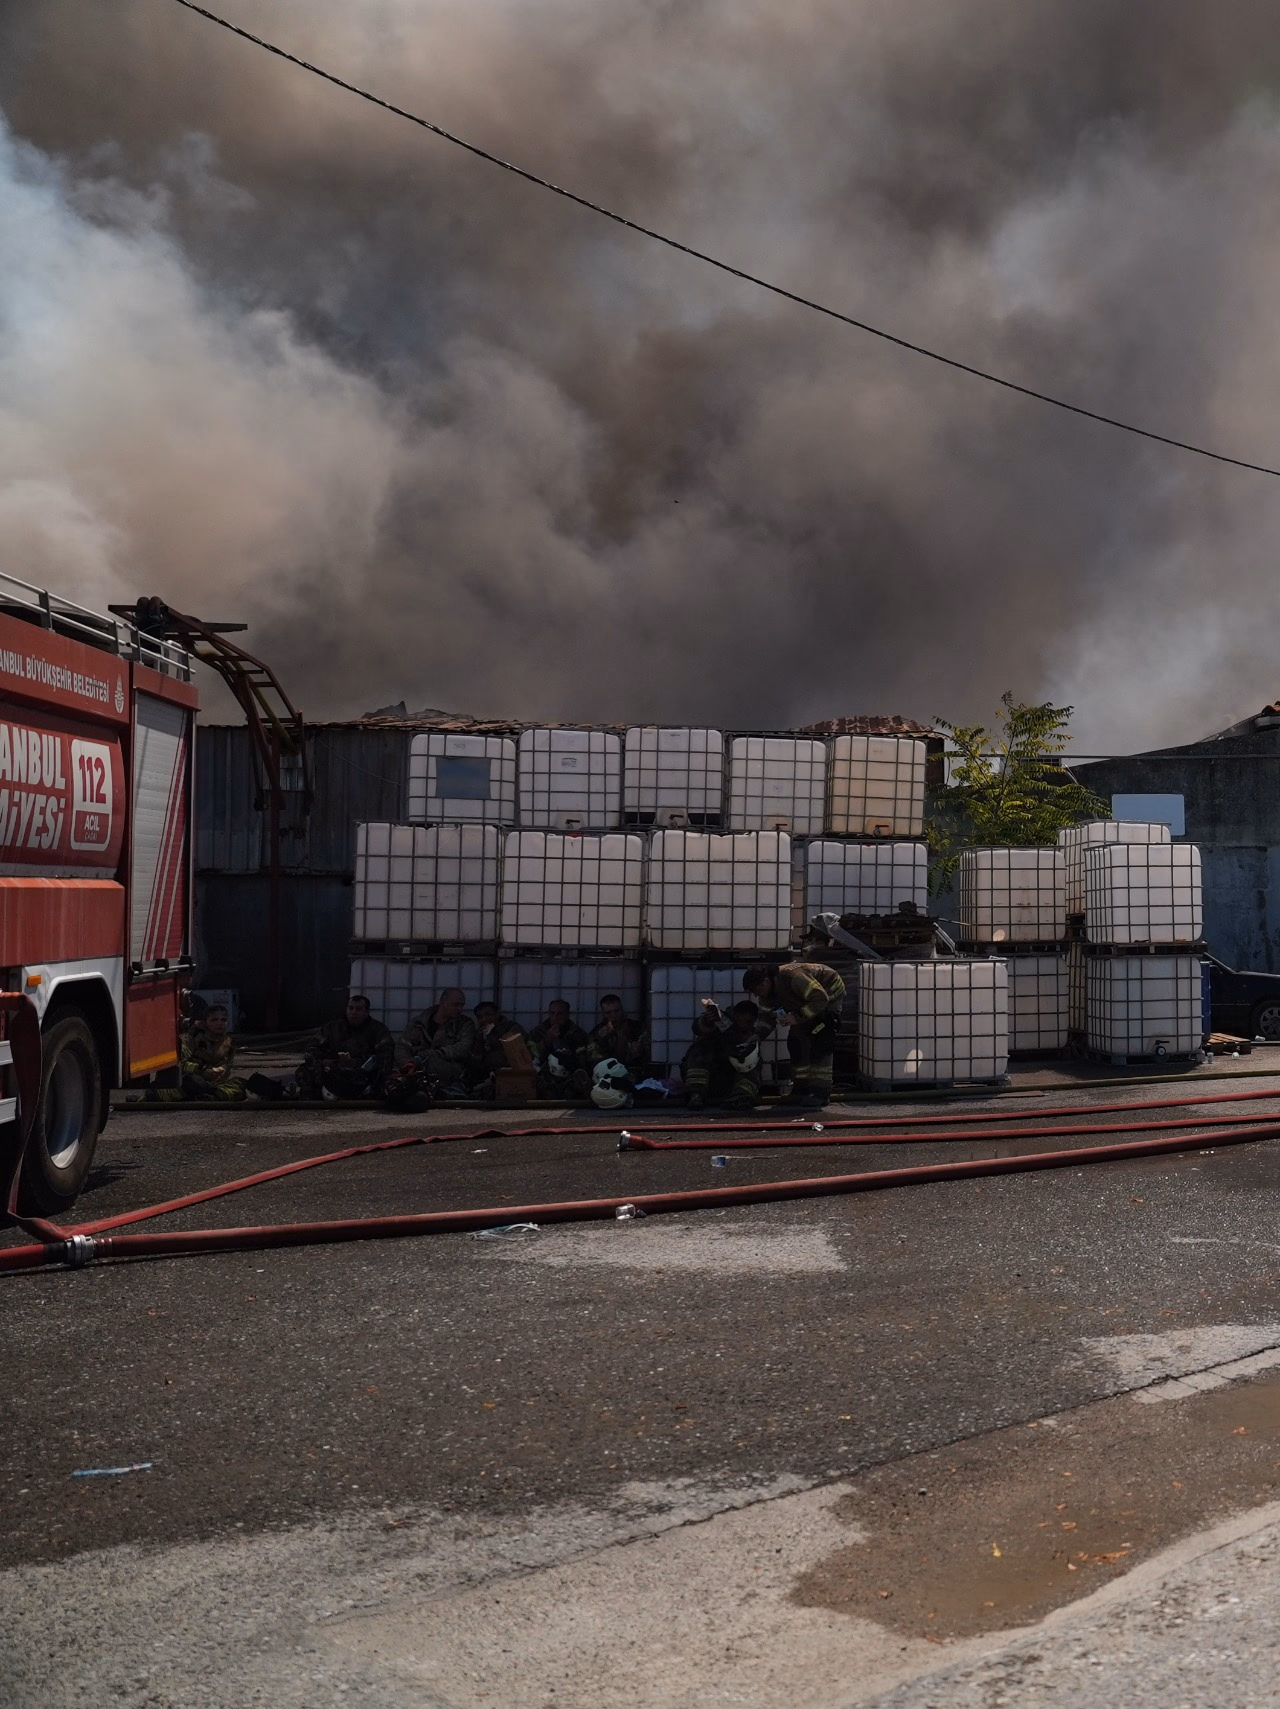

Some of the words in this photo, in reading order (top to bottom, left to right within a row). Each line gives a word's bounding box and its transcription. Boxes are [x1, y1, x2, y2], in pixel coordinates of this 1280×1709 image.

[26, 654, 72, 692] BÜYÜKŞEHİR
[73, 672, 110, 703] BELEDİYESİ
[79, 754, 107, 804] 112
